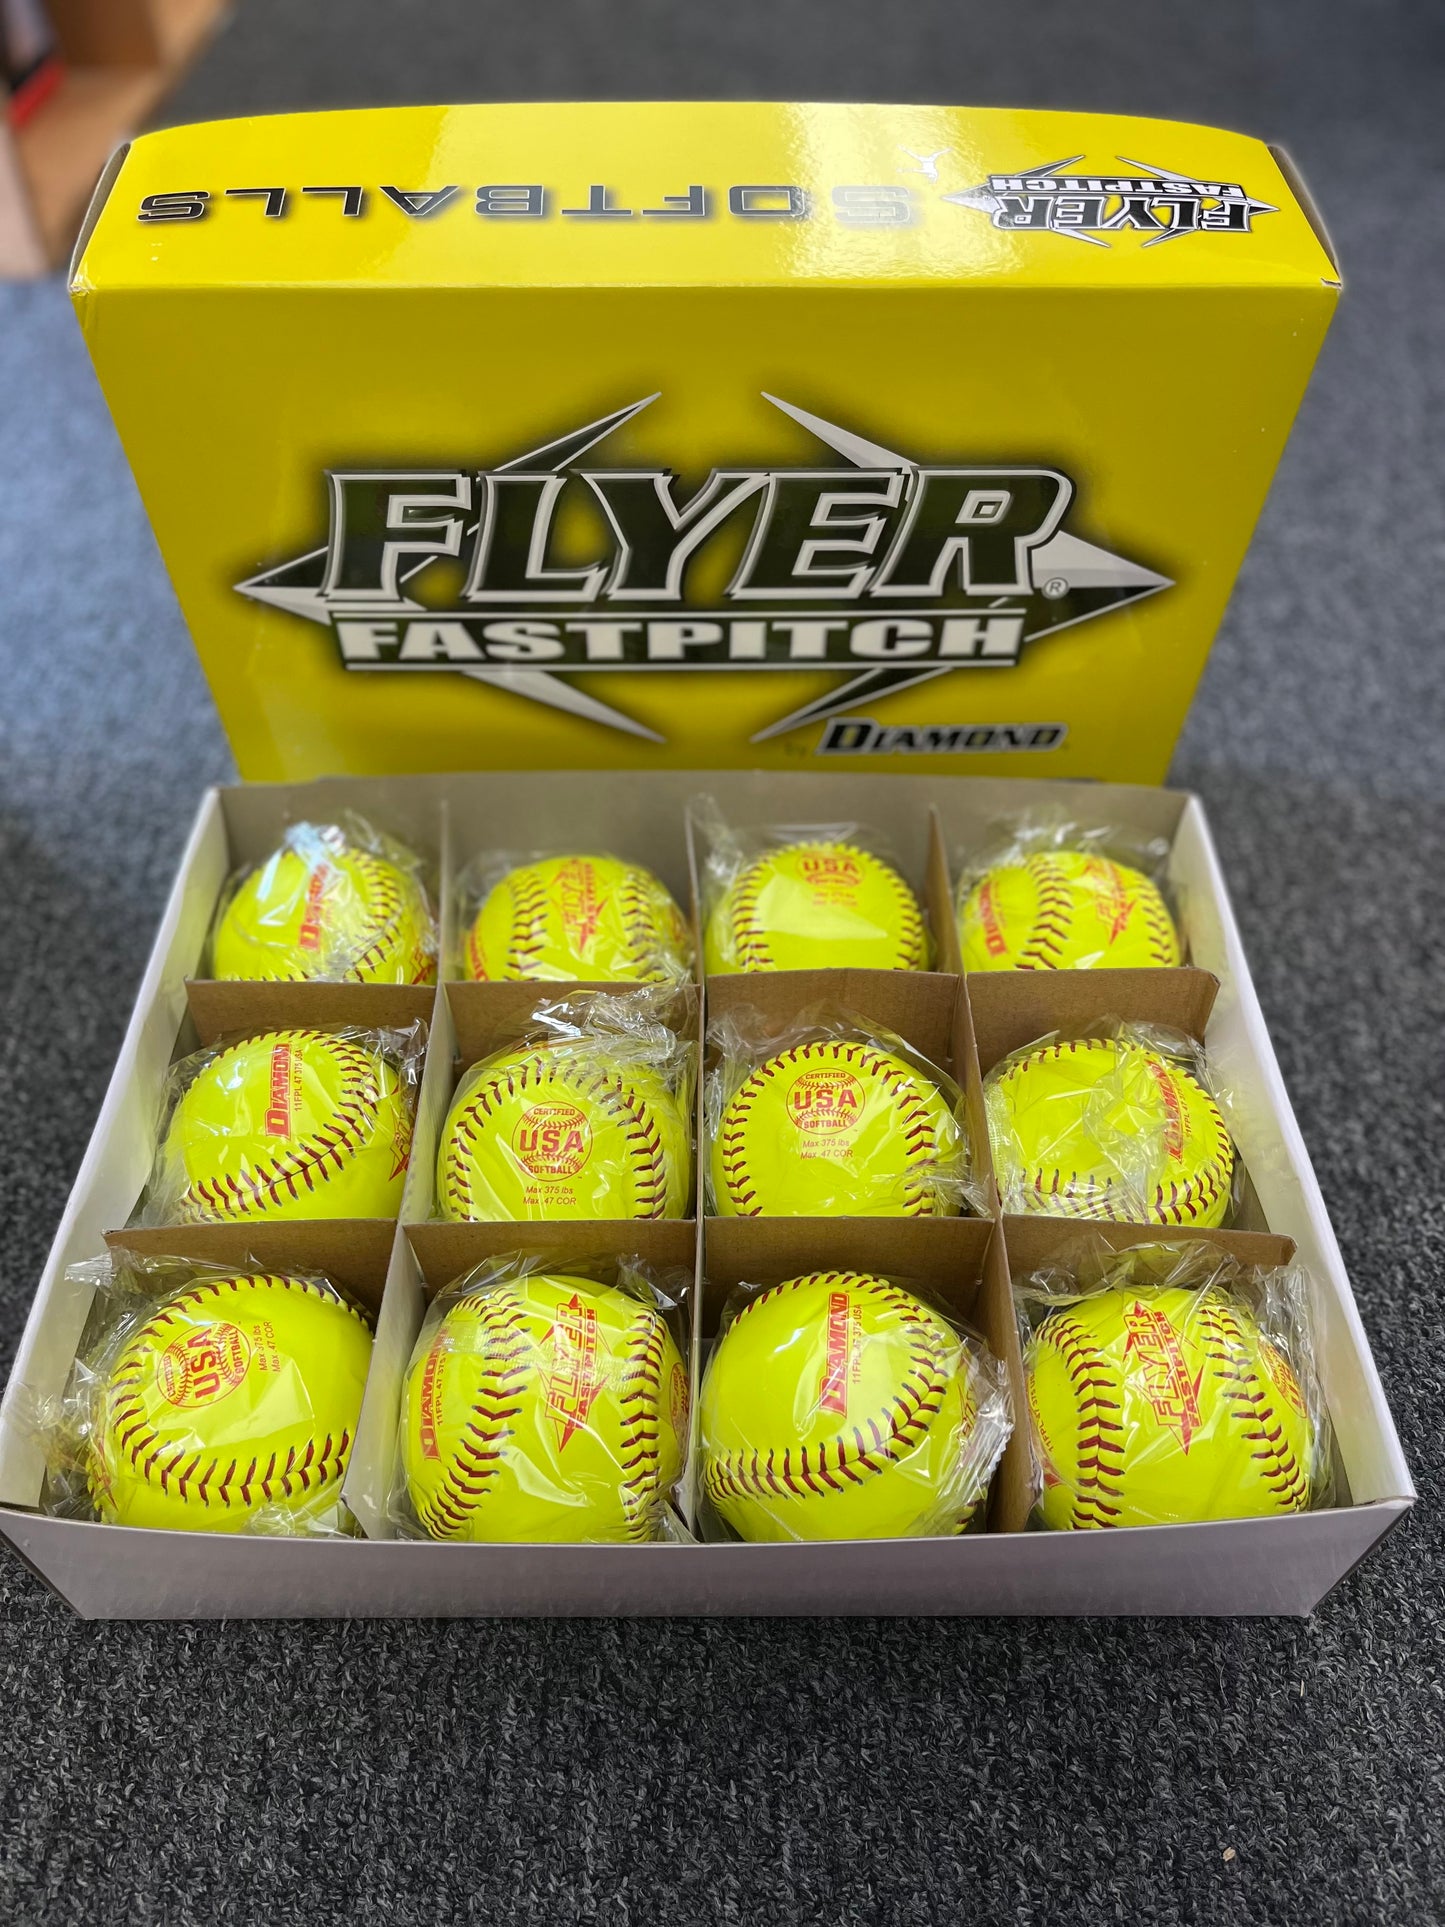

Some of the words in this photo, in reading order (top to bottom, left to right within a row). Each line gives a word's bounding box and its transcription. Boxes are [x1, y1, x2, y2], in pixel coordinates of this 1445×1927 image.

[993, 178, 1247, 199] FASTPITCH
[137, 185, 911, 223] SOFTBALLS
[992, 195, 1251, 231] FLYER
[323, 467, 1075, 601] FLYER
[335, 616, 1023, 661] FASTPITCH
[817, 717, 1068, 755] DIAMOND
[803, 858, 859, 874] USA
[805, 1072, 847, 1080] CERTIFIED
[293, 1086, 303, 1112] 11FPL
[794, 1089, 858, 1110] USA
[533, 1107, 576, 1116] CERTIFIED
[803, 1119, 848, 1129] SOFTBALL
[519, 1129, 584, 1153] USA
[802, 1140, 819, 1149] Max
[820, 1138, 836, 1147] 375
[837, 1139, 850, 1147] lbs
[800, 1151, 817, 1160] Max
[833, 1149, 854, 1158] COR
[529, 1165, 573, 1175] SOFTBALL
[522, 1196, 540, 1205] Max
[556, 1197, 577, 1206] COR
[525, 1186, 542, 1195] Max
[544, 1186, 560, 1194] 375
[561, 1187, 574, 1195] lbs
[853, 1304, 862, 1319] USA
[253, 1325, 262, 1336] lbs
[263, 1321, 275, 1339] COR
[853, 1320, 862, 1336] 375
[229, 1330, 245, 1374] SOFTBALL
[254, 1337, 264, 1351] 375
[187, 1328, 220, 1399] USA
[258, 1353, 268, 1371] Max
[272, 1354, 281, 1372] Max
[545, 1303, 584, 1427] FLYER
[819, 1291, 849, 1419] DIAMOND
[163, 1355, 176, 1398] CERTIFIED
[575, 1308, 597, 1429] FASTPITCH
[1124, 1309, 1180, 1427] FLYER
[1153, 1310, 1200, 1427] FASTPITCH
[435, 1393, 443, 1426] 11FPL
[1039, 1420, 1055, 1452] 11FPL
